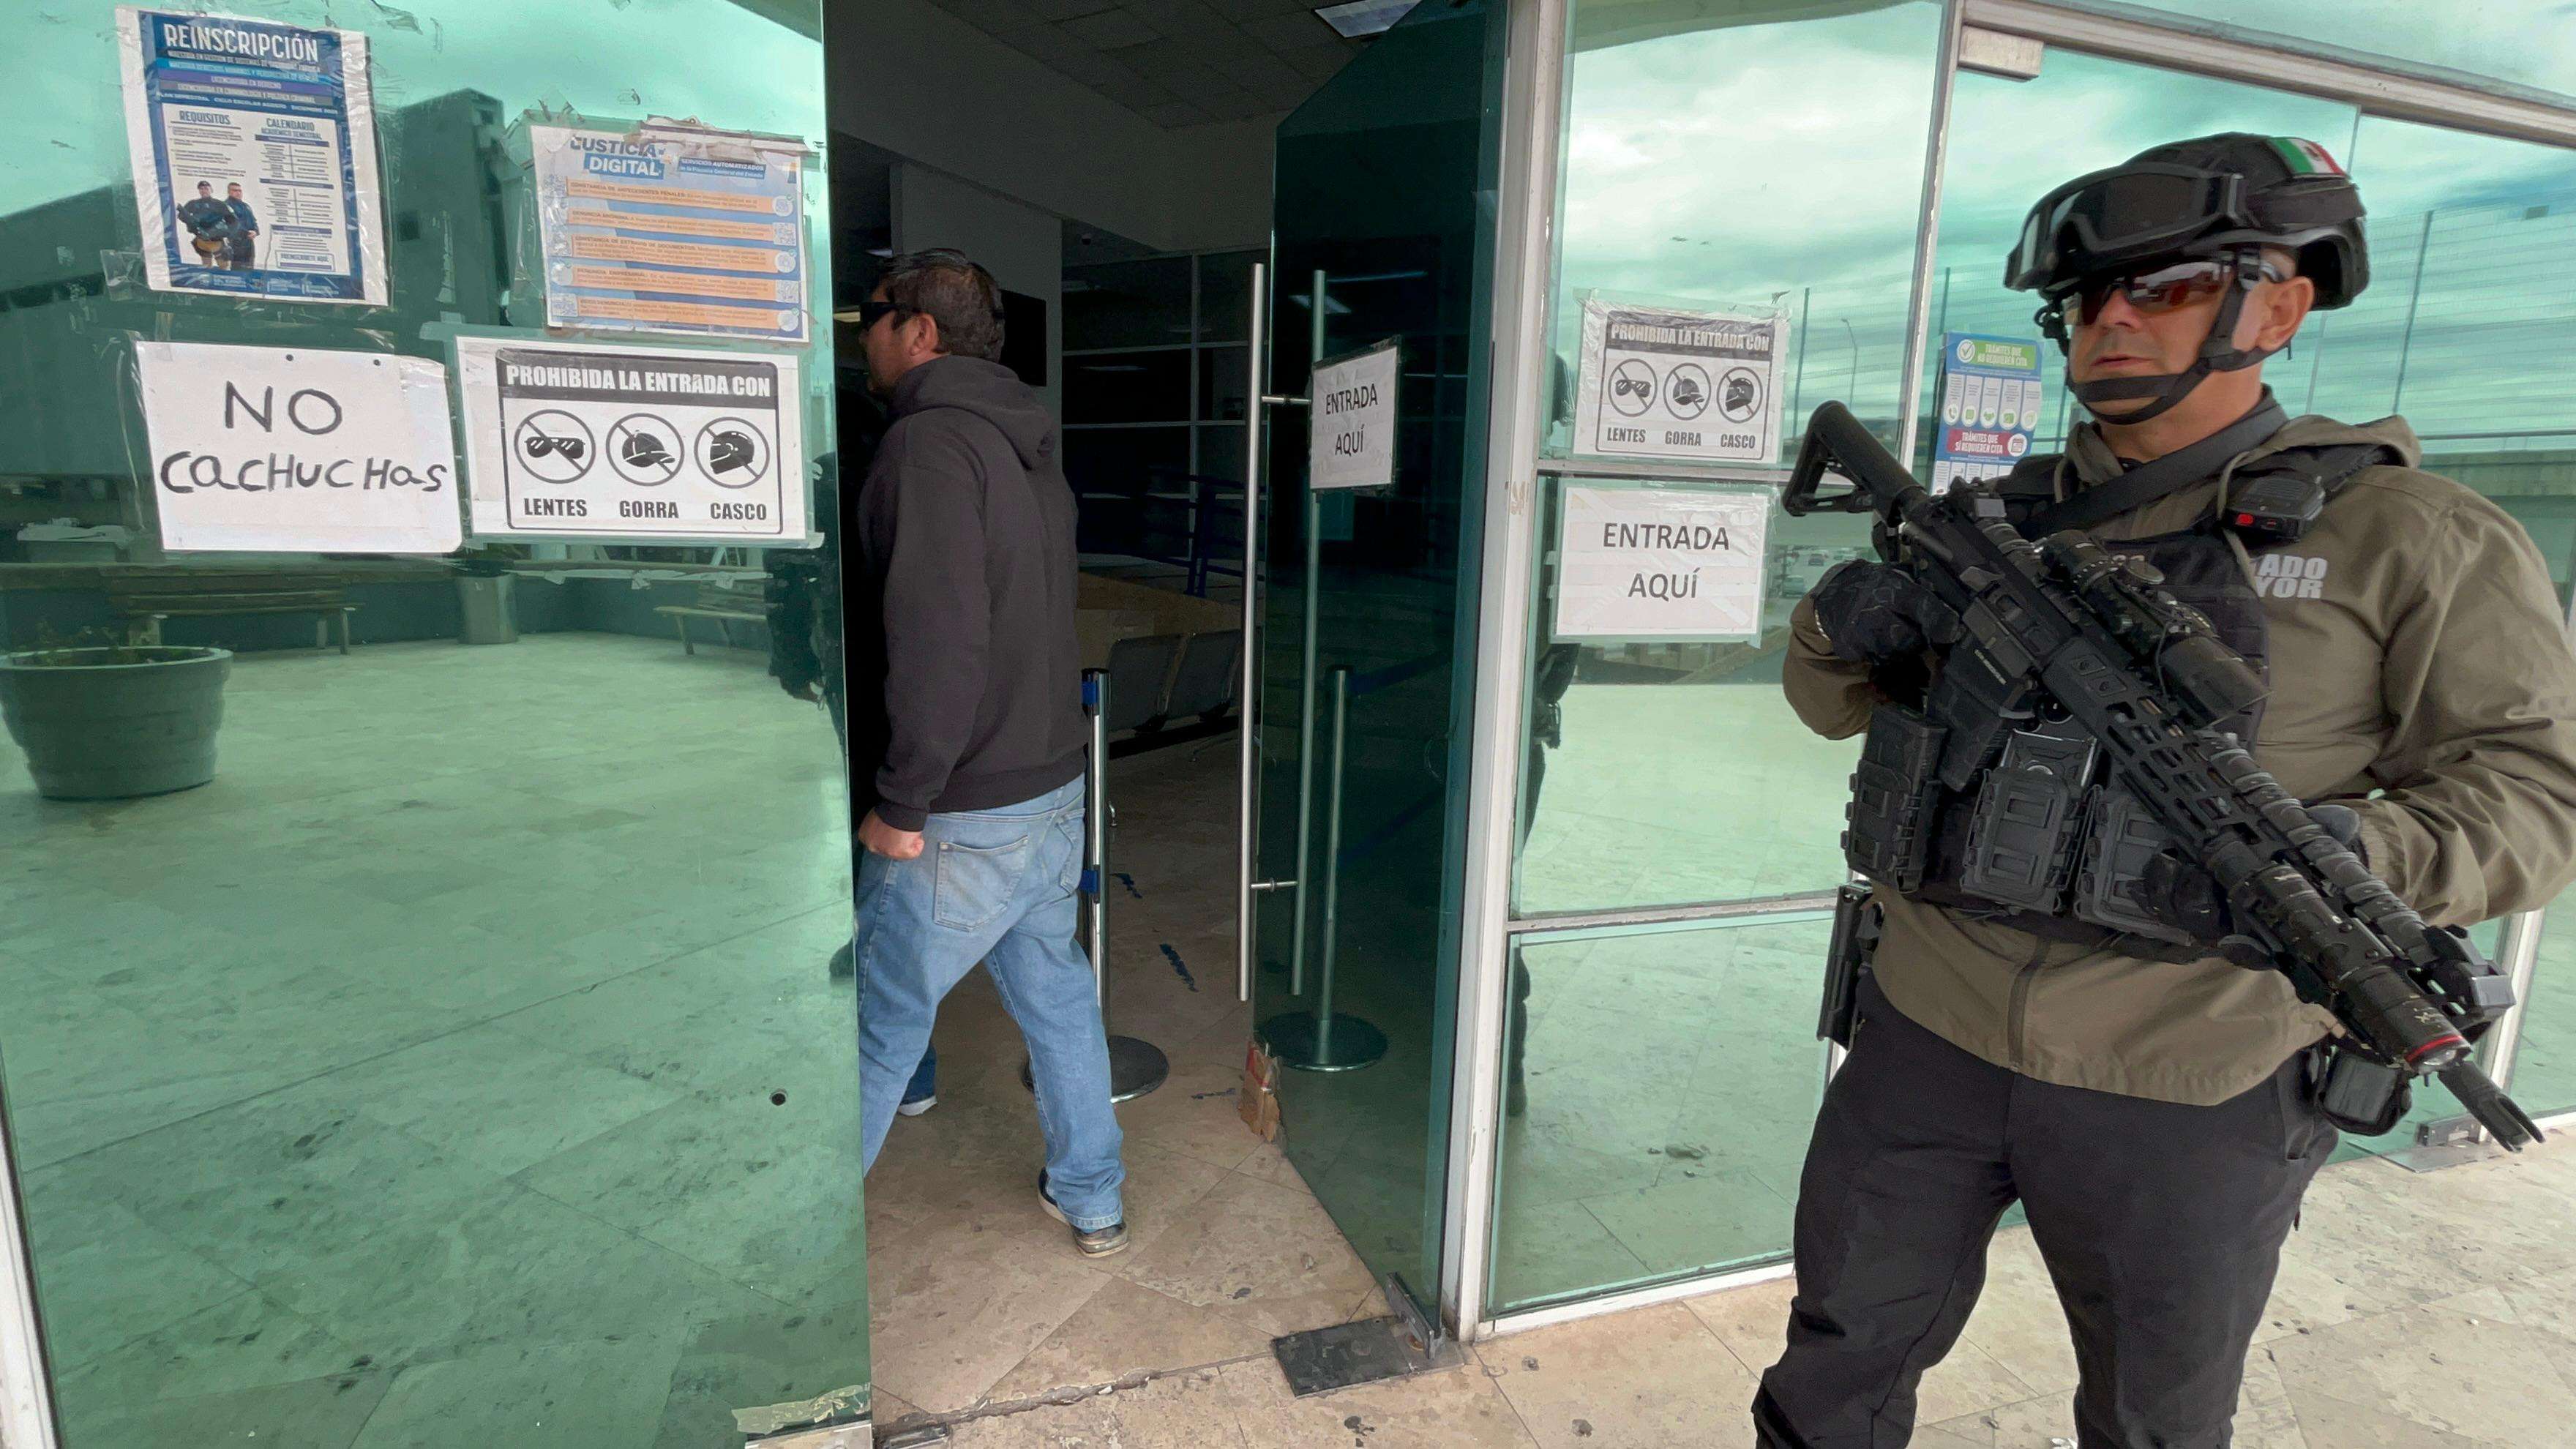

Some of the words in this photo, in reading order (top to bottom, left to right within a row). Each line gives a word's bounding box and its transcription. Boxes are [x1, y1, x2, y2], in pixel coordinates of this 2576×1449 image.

[163, 23, 319, 62] REINSCRIPCIÓN
[179, 111, 231, 125] REQUISITOS
[266, 118, 315, 132] CALENDARIO
[589, 156, 660, 176] DIGITAL
[713, 162, 764, 171] AUTOMATIZADOS
[1611, 323, 1676, 345] PROHIBIDA
[1678, 330, 1693, 346] LA
[1694, 332, 1745, 349] ENTRADA
[1745, 336, 1770, 351] CON
[506, 364, 615, 390] PROHIBIDA
[618, 370, 642, 391] LA
[645, 372, 730, 396] ENTRADA
[733, 375, 771, 397] CON
[225, 381, 342, 435] NO
[1325, 383, 1378, 415] ENTRADA
[1335, 424, 1365, 457] AQUÍ
[1607, 427, 1647, 443] LENTES
[1665, 430, 1701, 446] GORRA
[1721, 433, 1756, 449] CASCO
[1988, 434, 1999, 443] QUE
[1961, 441, 1990, 453] REQUIEREN
[1991, 444, 2003, 454] CITA
[524, 498, 588, 517] LENTES
[619, 501, 679, 518] GORRA
[710, 502, 767, 520] CASCO
[1603, 523, 1730, 550] ENTRADA
[2249, 554, 2327, 580] ADO
[1628, 567, 1701, 602] AQUÍ
